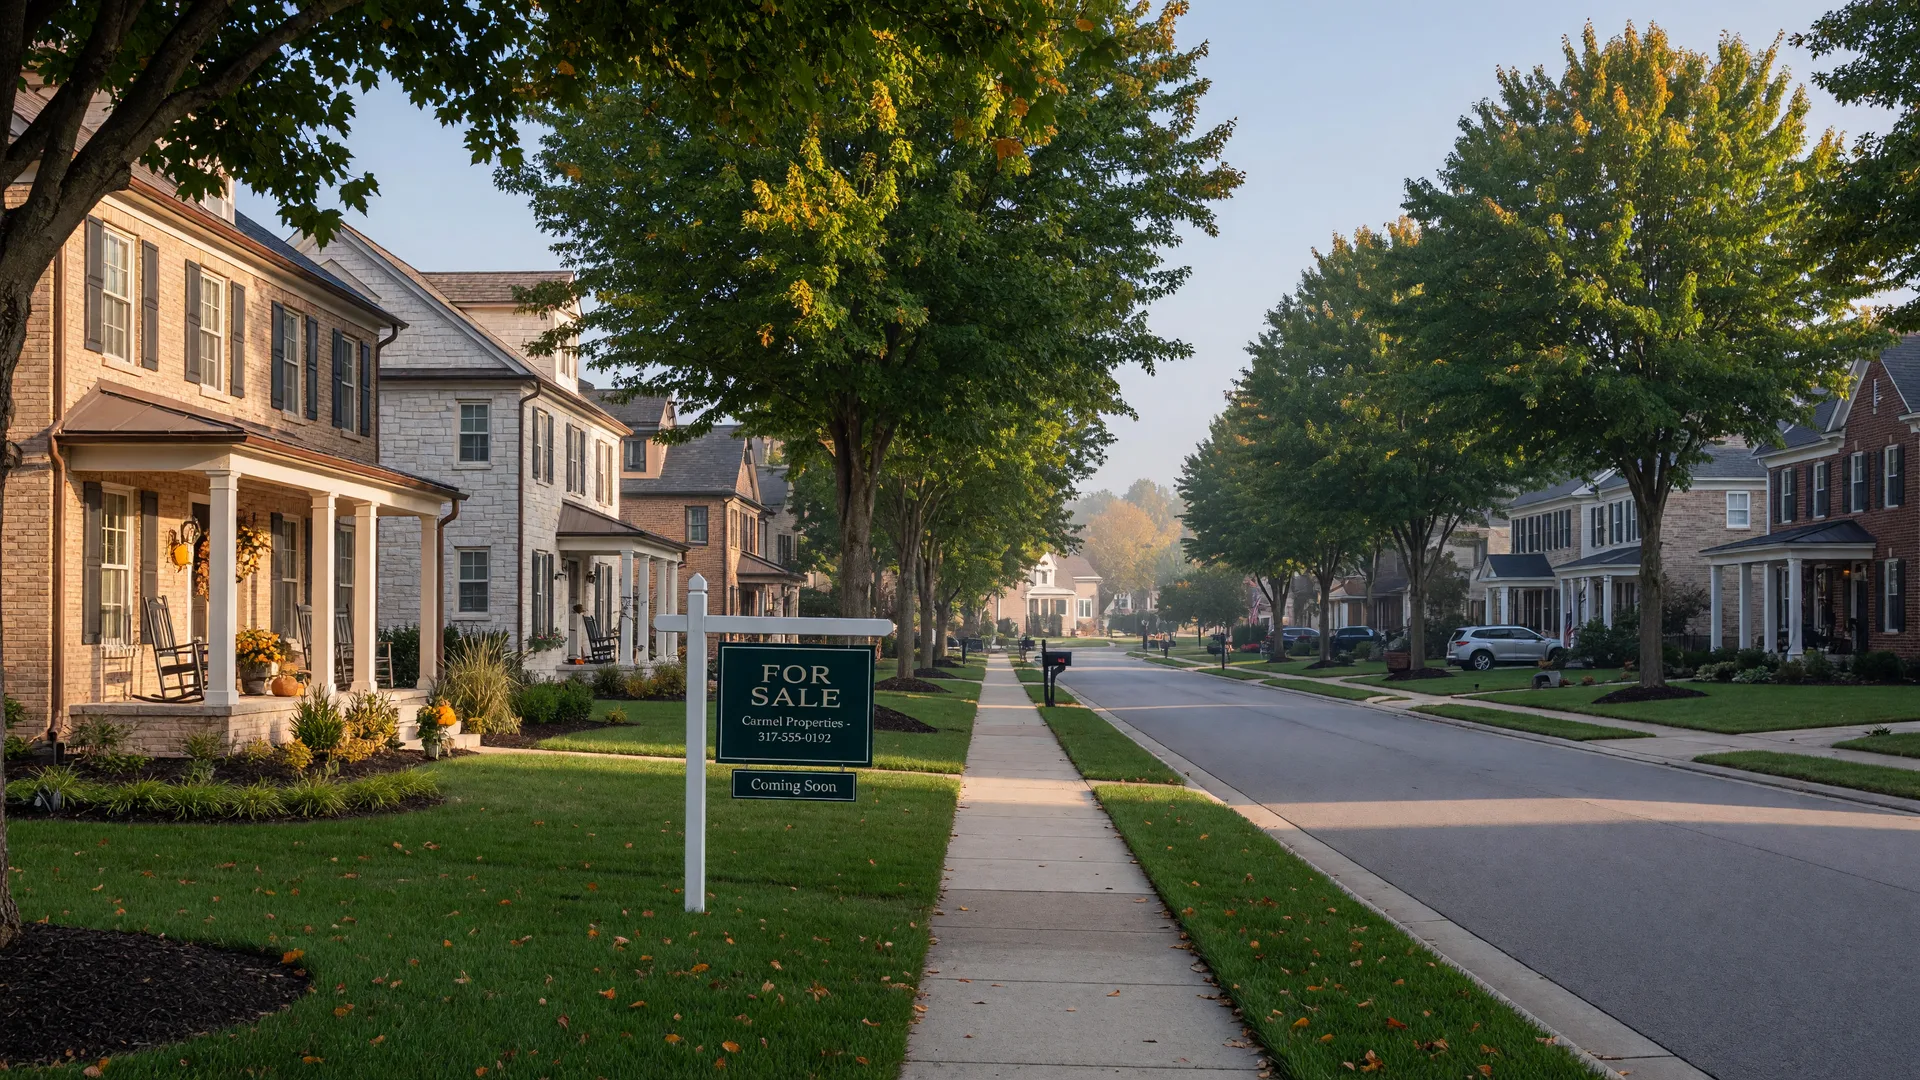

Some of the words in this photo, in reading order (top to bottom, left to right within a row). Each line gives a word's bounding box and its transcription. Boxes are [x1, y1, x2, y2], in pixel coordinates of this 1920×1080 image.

[761, 664, 831, 684] FOR
[751, 687, 841, 708] SALE
[742, 715, 783, 727] Carmel
[786, 717, 844, 730] Properties
[758, 731, 832, 744] 317-555-0192
[750, 778, 801, 794] Coming
[804, 780, 837, 793] Soon
